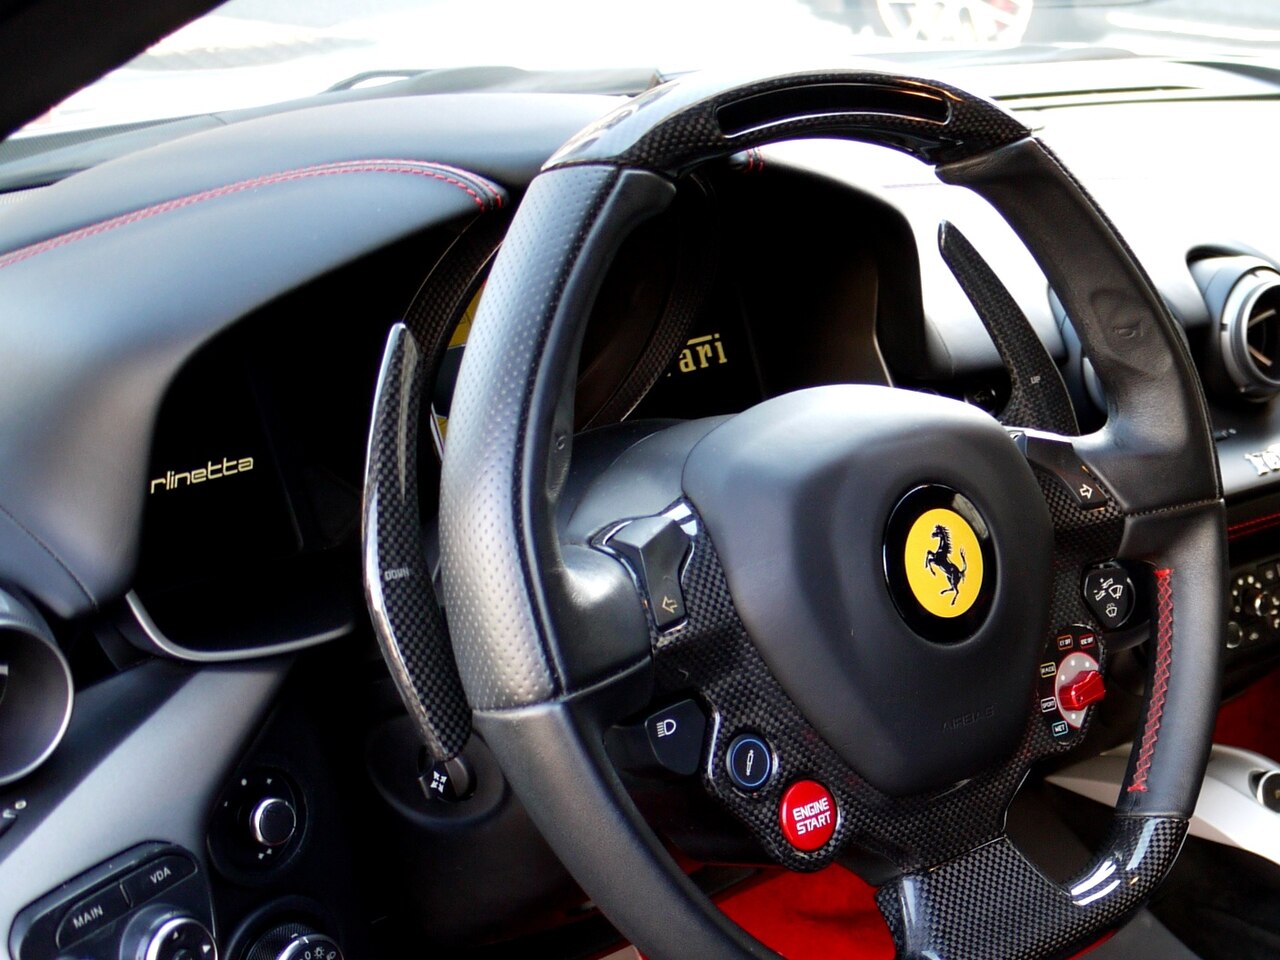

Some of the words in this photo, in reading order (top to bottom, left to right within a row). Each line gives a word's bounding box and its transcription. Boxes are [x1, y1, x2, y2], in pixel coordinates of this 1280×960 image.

[1030, 375, 1041, 384] UP
[150, 456, 254, 494] rlinetta
[384, 567, 410, 582] DOWN
[792, 797, 829, 821] ENGINE
[796, 811, 831, 835] START
[150, 866, 171, 884] VDA
[73, 905, 103, 929] MAIN
